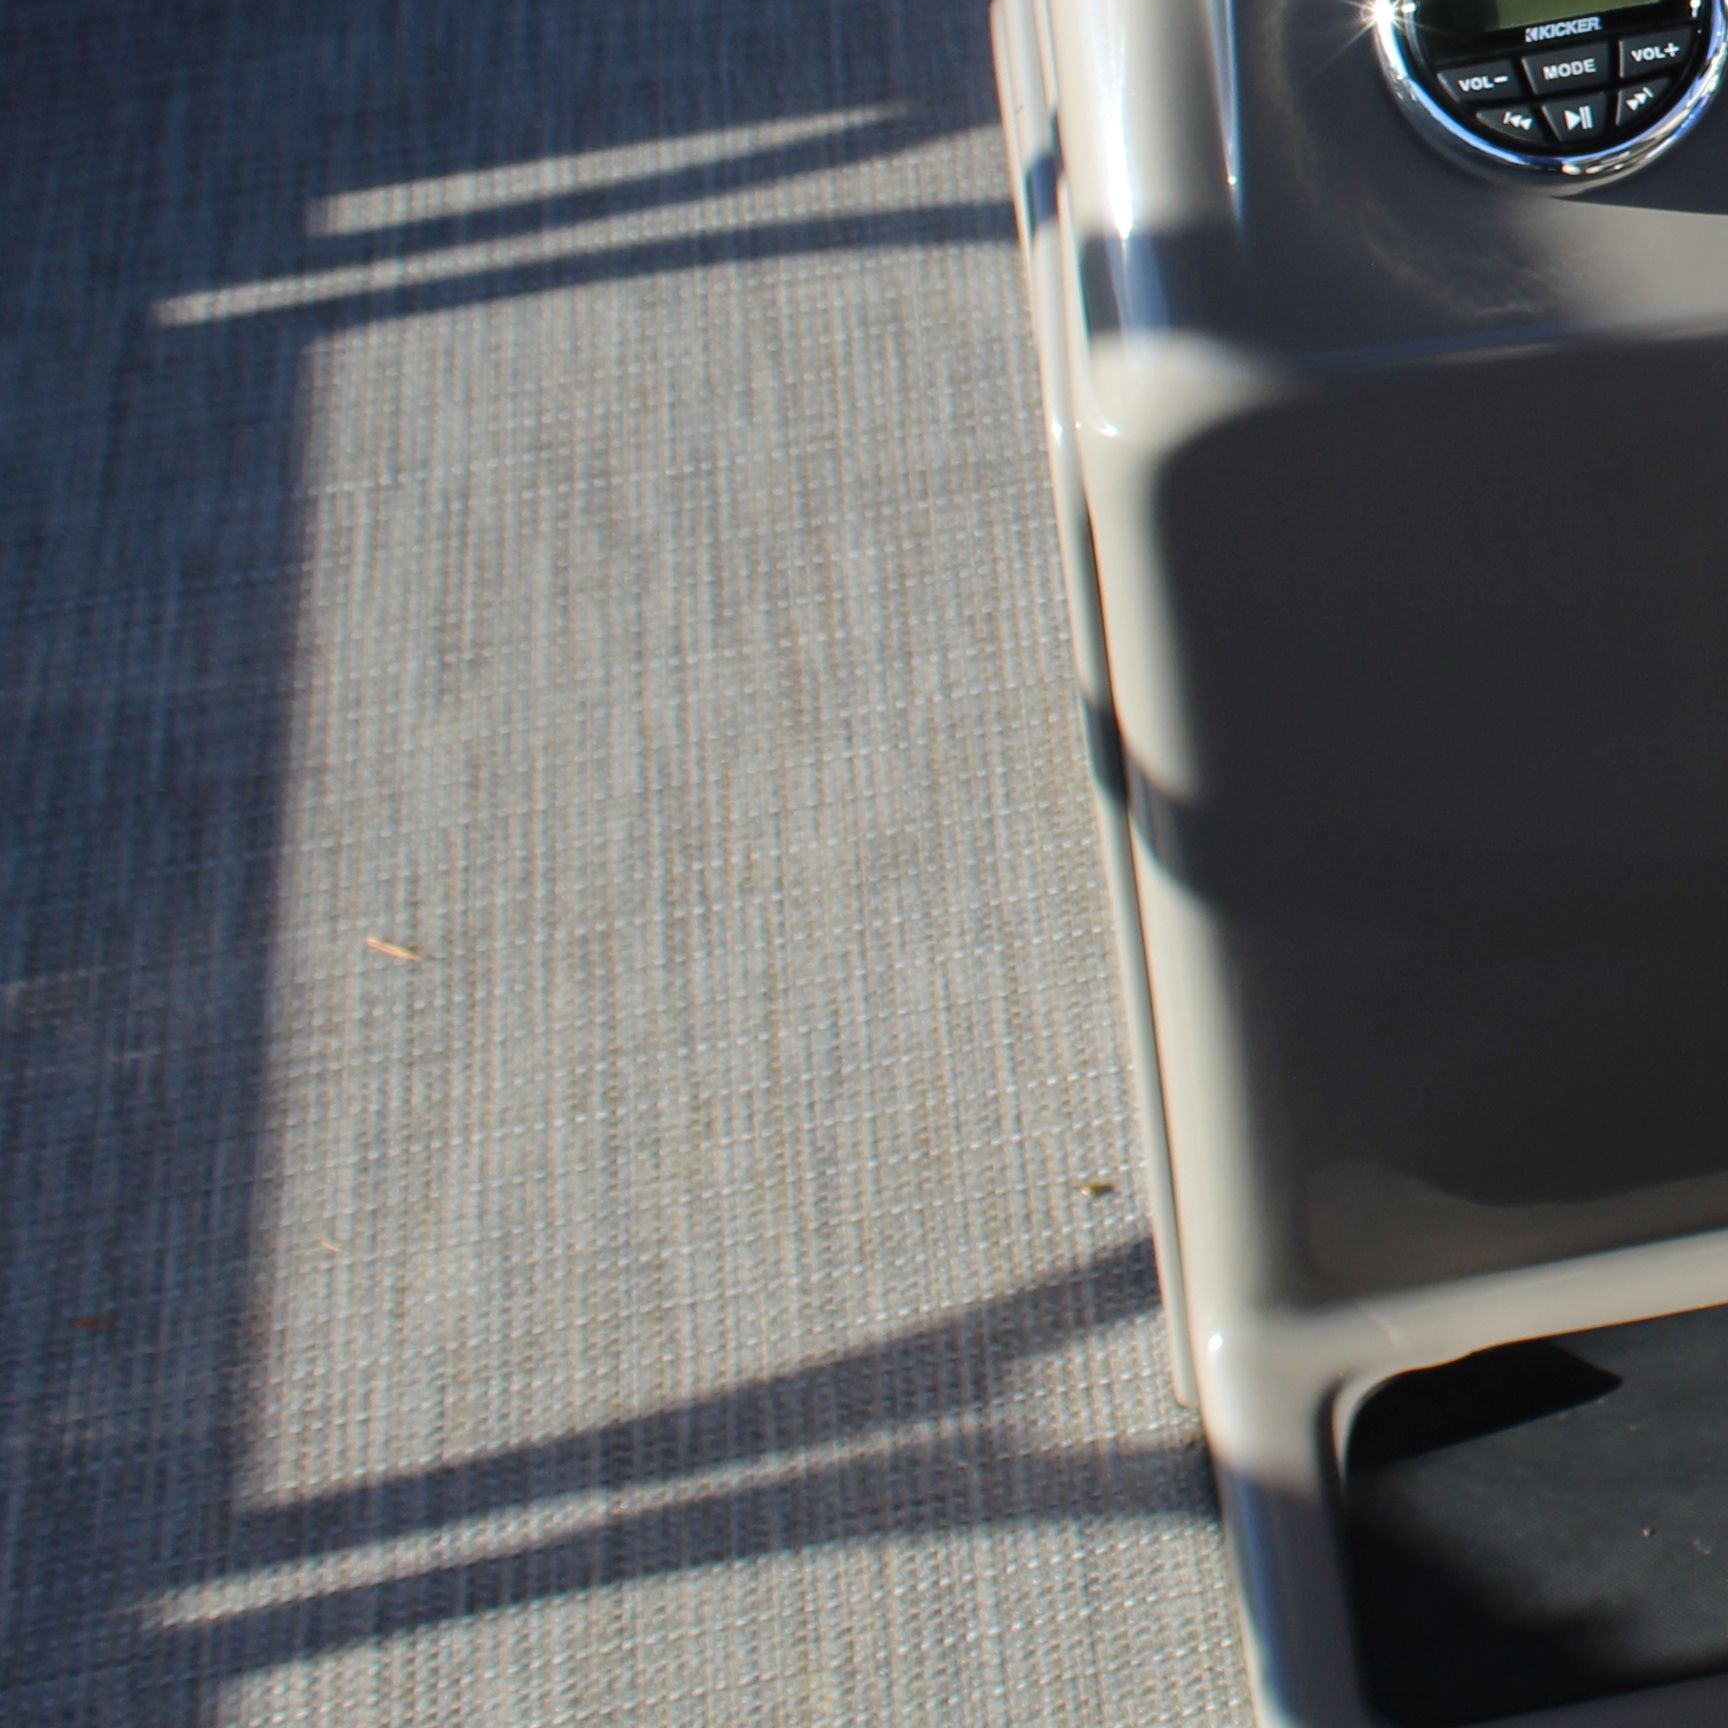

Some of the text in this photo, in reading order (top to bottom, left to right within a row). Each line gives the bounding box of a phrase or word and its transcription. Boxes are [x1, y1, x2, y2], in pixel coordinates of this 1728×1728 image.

[1538, 15, 1601, 39] KICKER
[1630, 42, 1680, 63] VOL+
[1543, 58, 1597, 81] MODE
